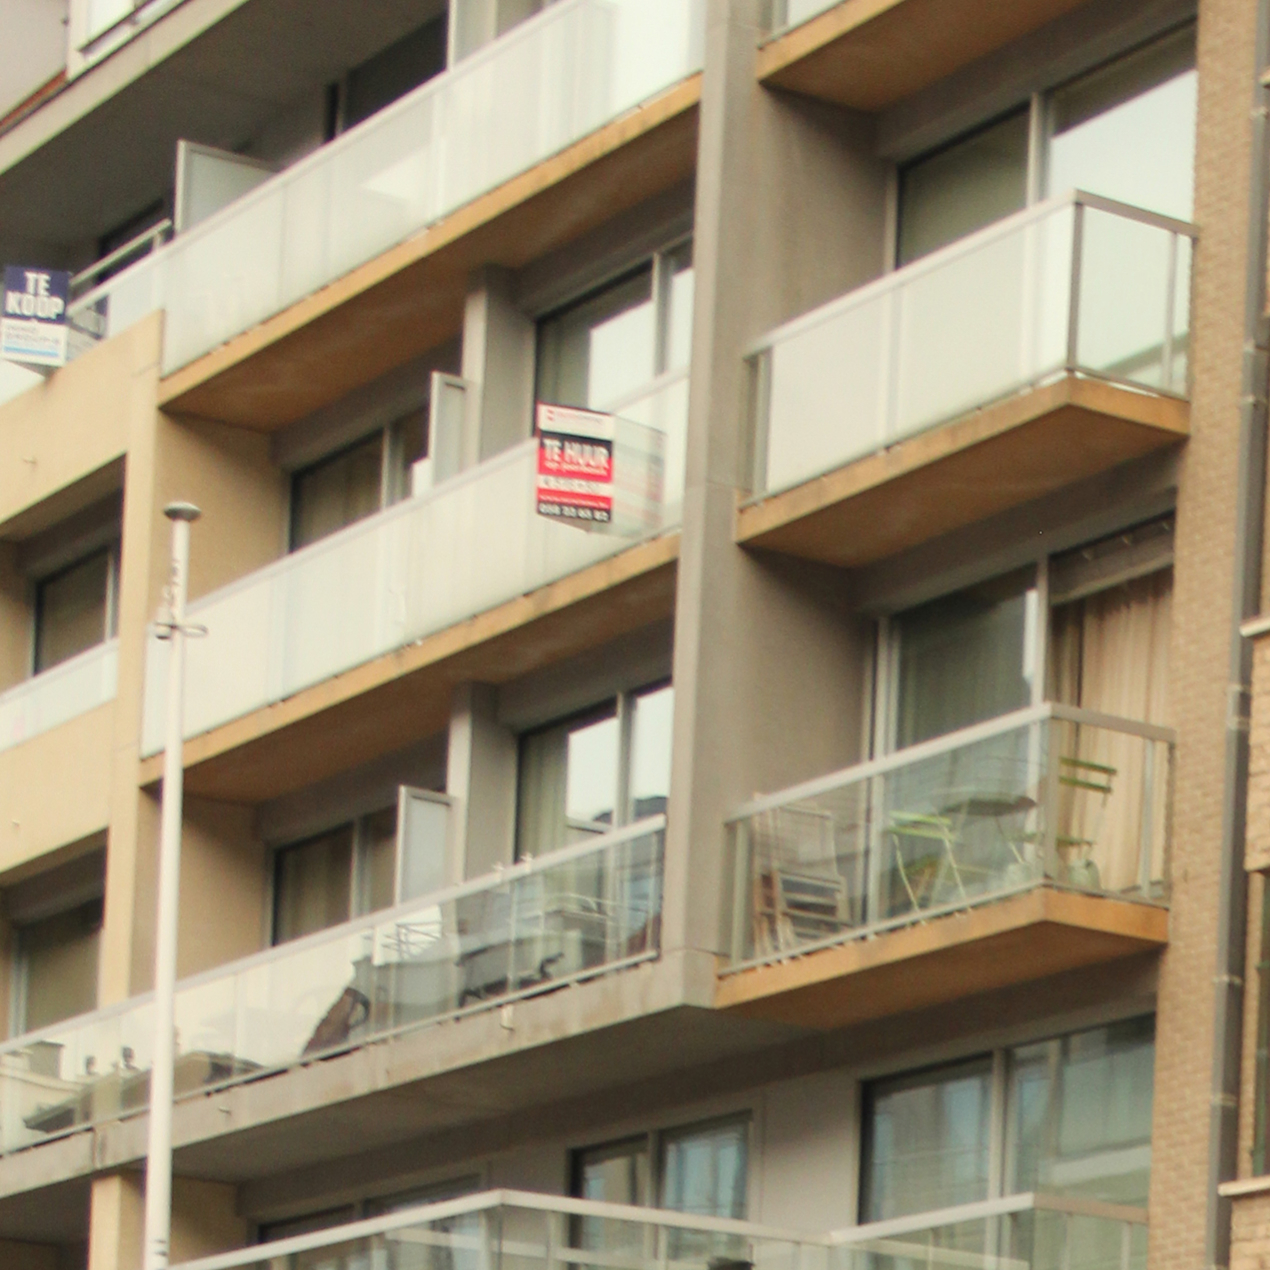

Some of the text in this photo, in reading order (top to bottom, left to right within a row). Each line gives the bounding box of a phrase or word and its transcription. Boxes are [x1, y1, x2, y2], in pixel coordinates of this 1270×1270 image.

[25, 271, 51, 297] TE
[6, 291, 65, 319] KOOP
[543, 438, 562, 461] TE
[564, 440, 610, 468] HUUR
